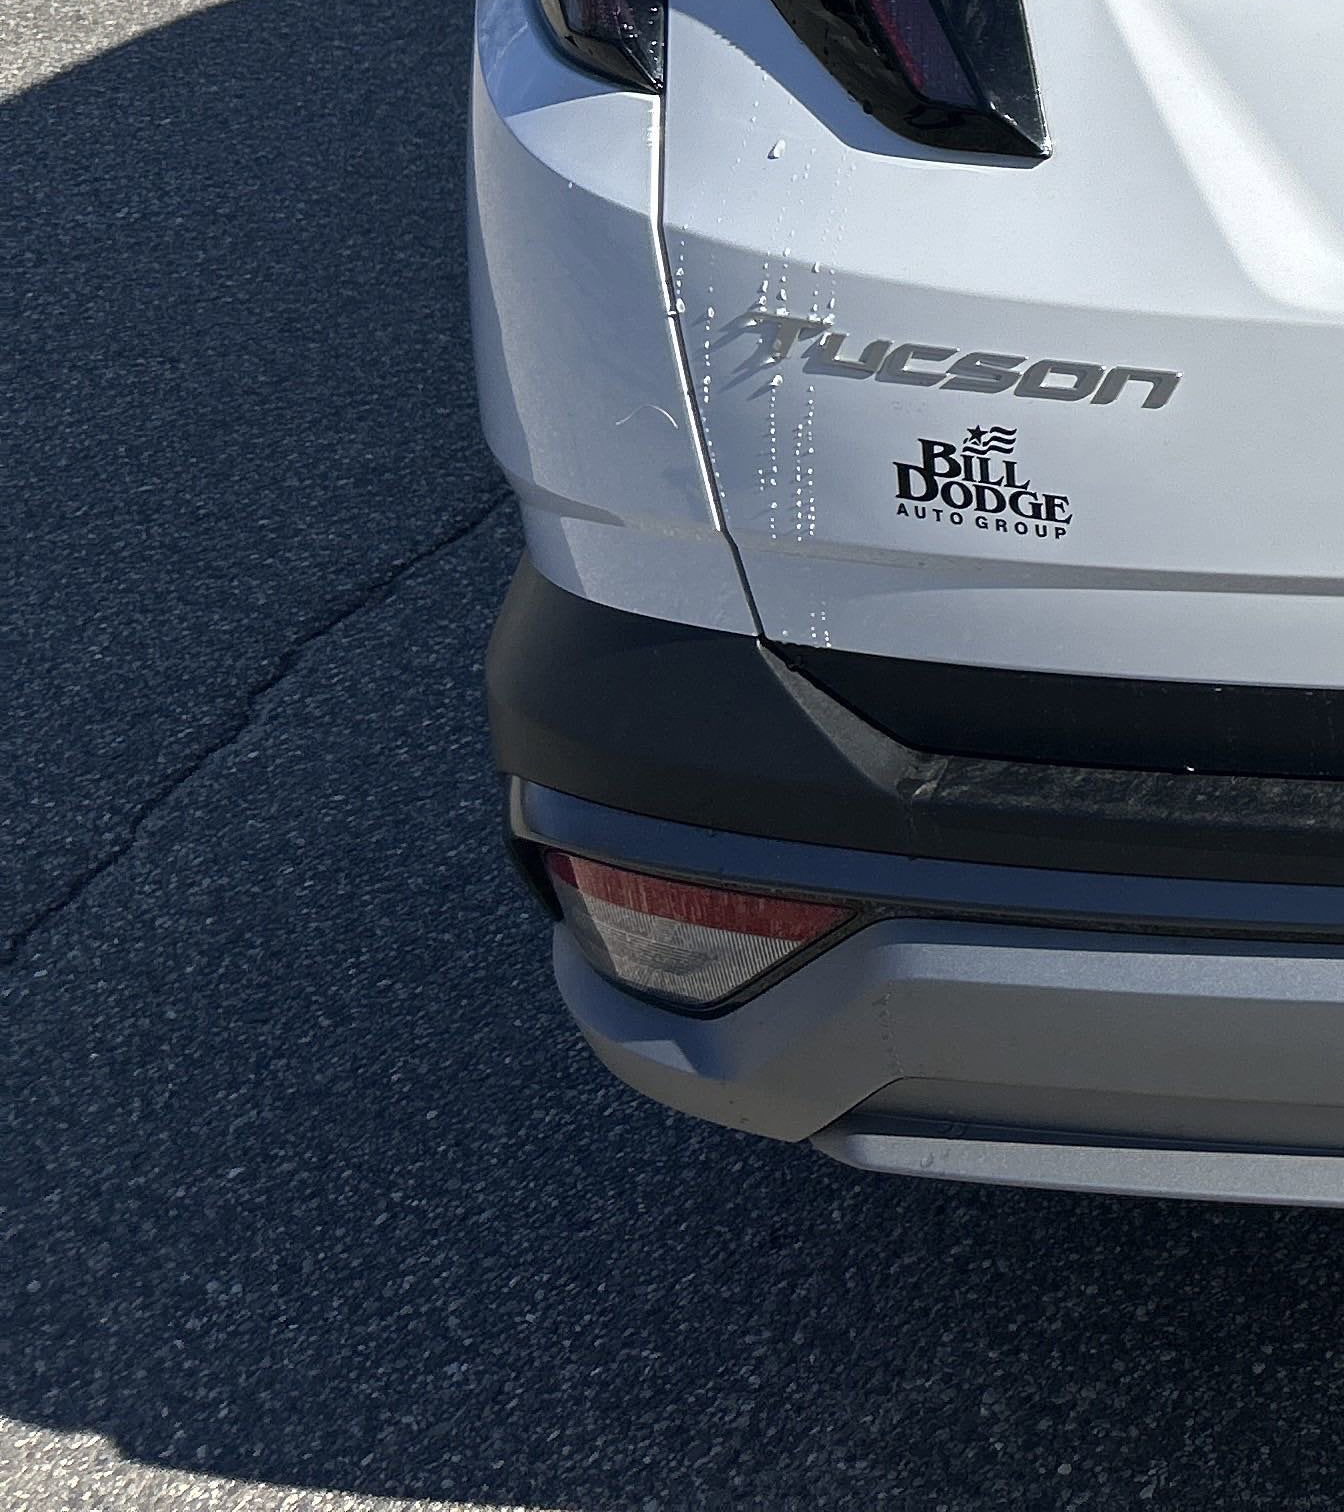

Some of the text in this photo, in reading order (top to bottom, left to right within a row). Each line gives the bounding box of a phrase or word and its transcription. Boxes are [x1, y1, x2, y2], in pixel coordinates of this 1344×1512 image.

[740, 310, 1181, 410] TUCSON
[893, 461, 1073, 525] DODGE
[918, 438, 1031, 490] BILL
[896, 503, 1067, 539] AUTO GROUP
